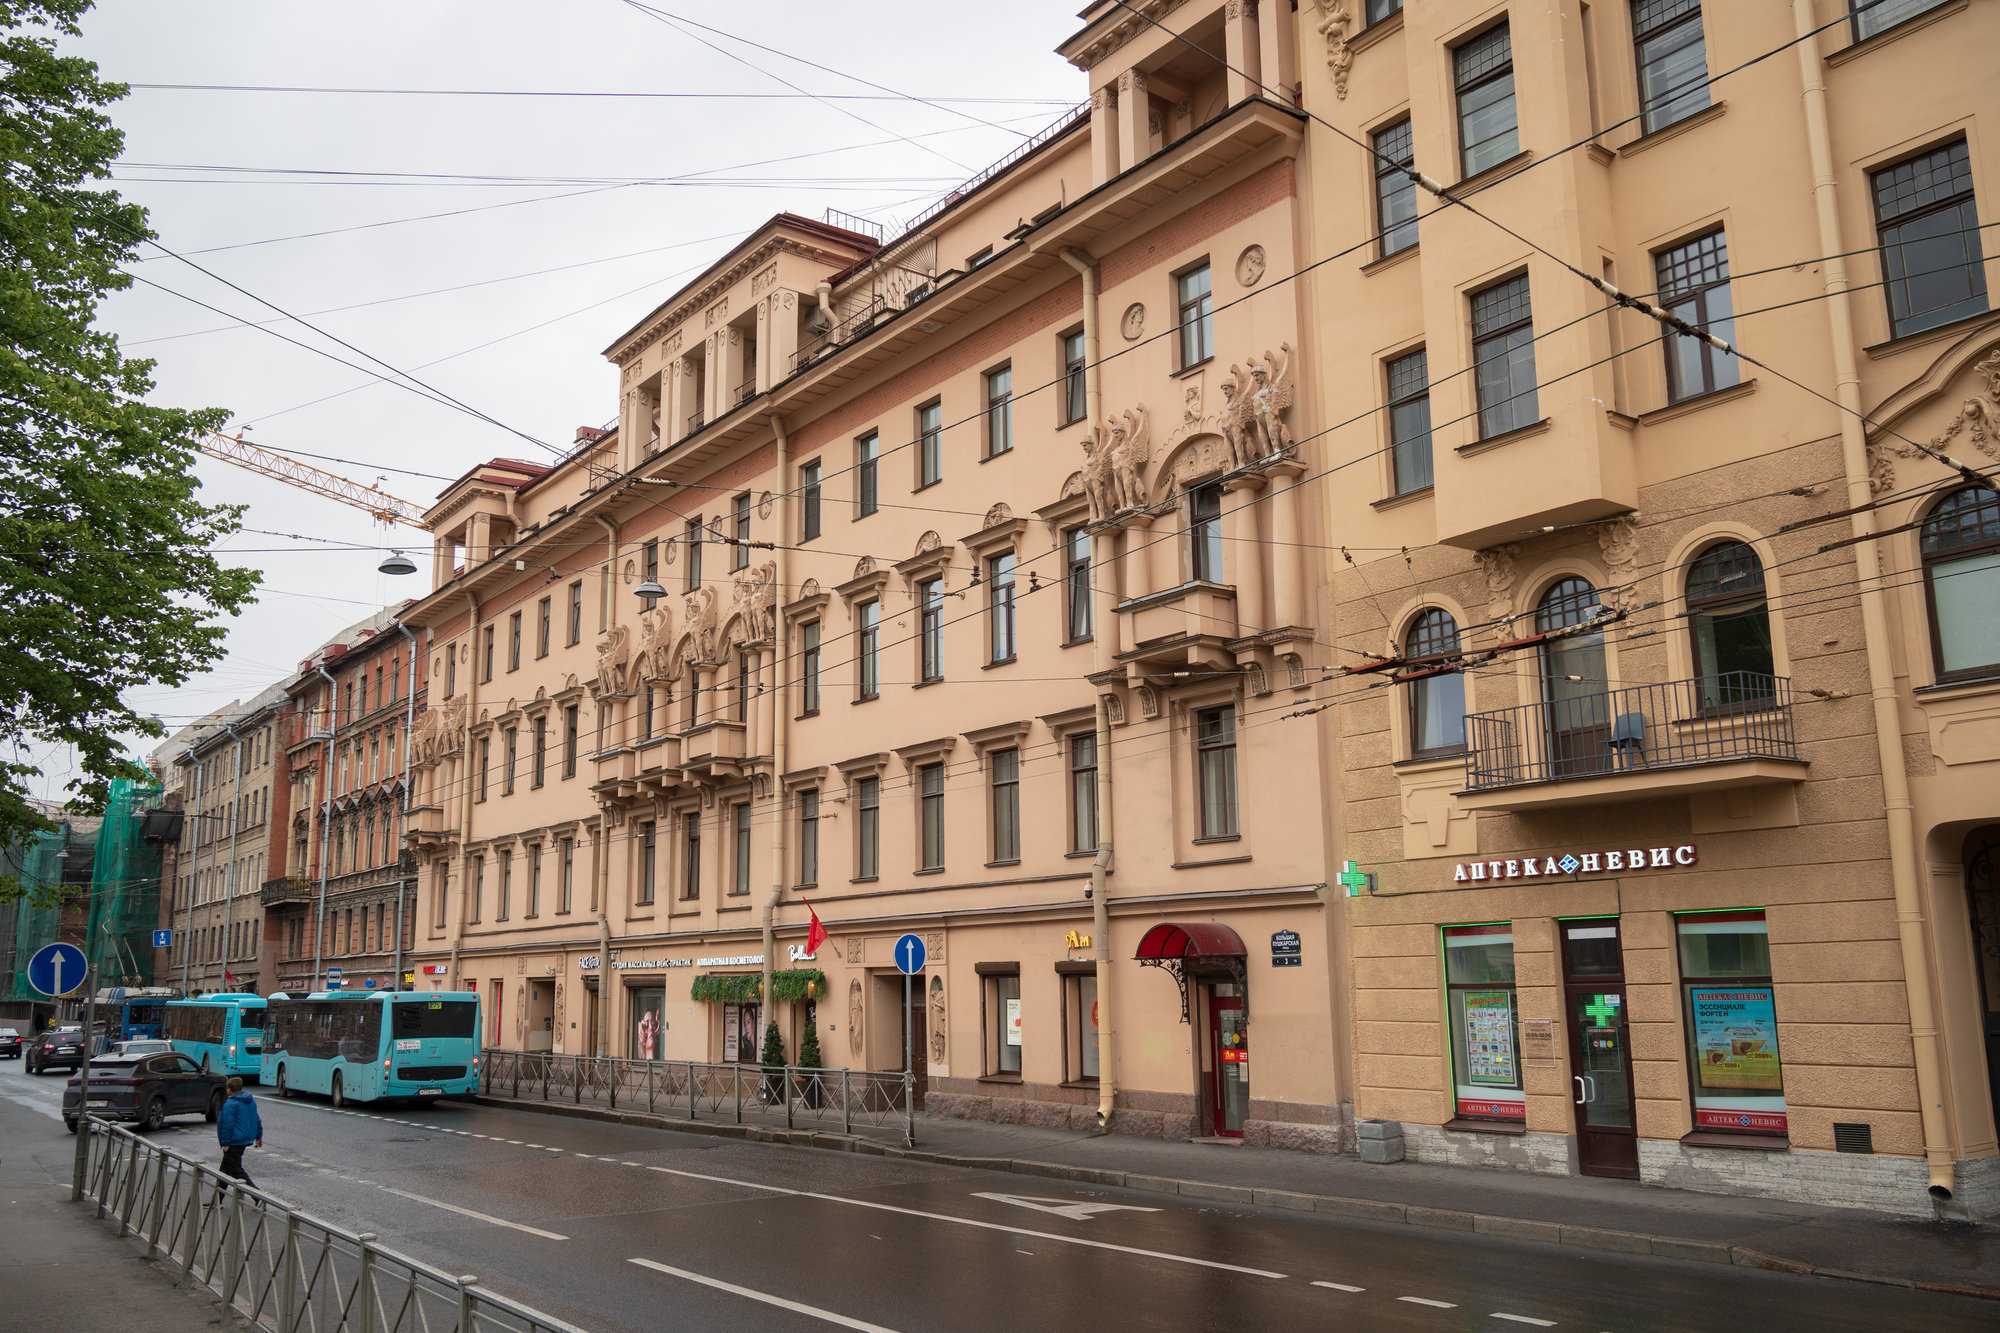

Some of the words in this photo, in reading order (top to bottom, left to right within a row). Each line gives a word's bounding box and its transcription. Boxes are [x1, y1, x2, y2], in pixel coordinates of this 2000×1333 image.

[1454, 857, 1559, 881] АПТЕКА
[1580, 845, 1696, 872] НЕВИС
[1706, 1115, 1739, 1124] АПТЕКА
[1751, 1118, 1782, 1126] НЕВИС
